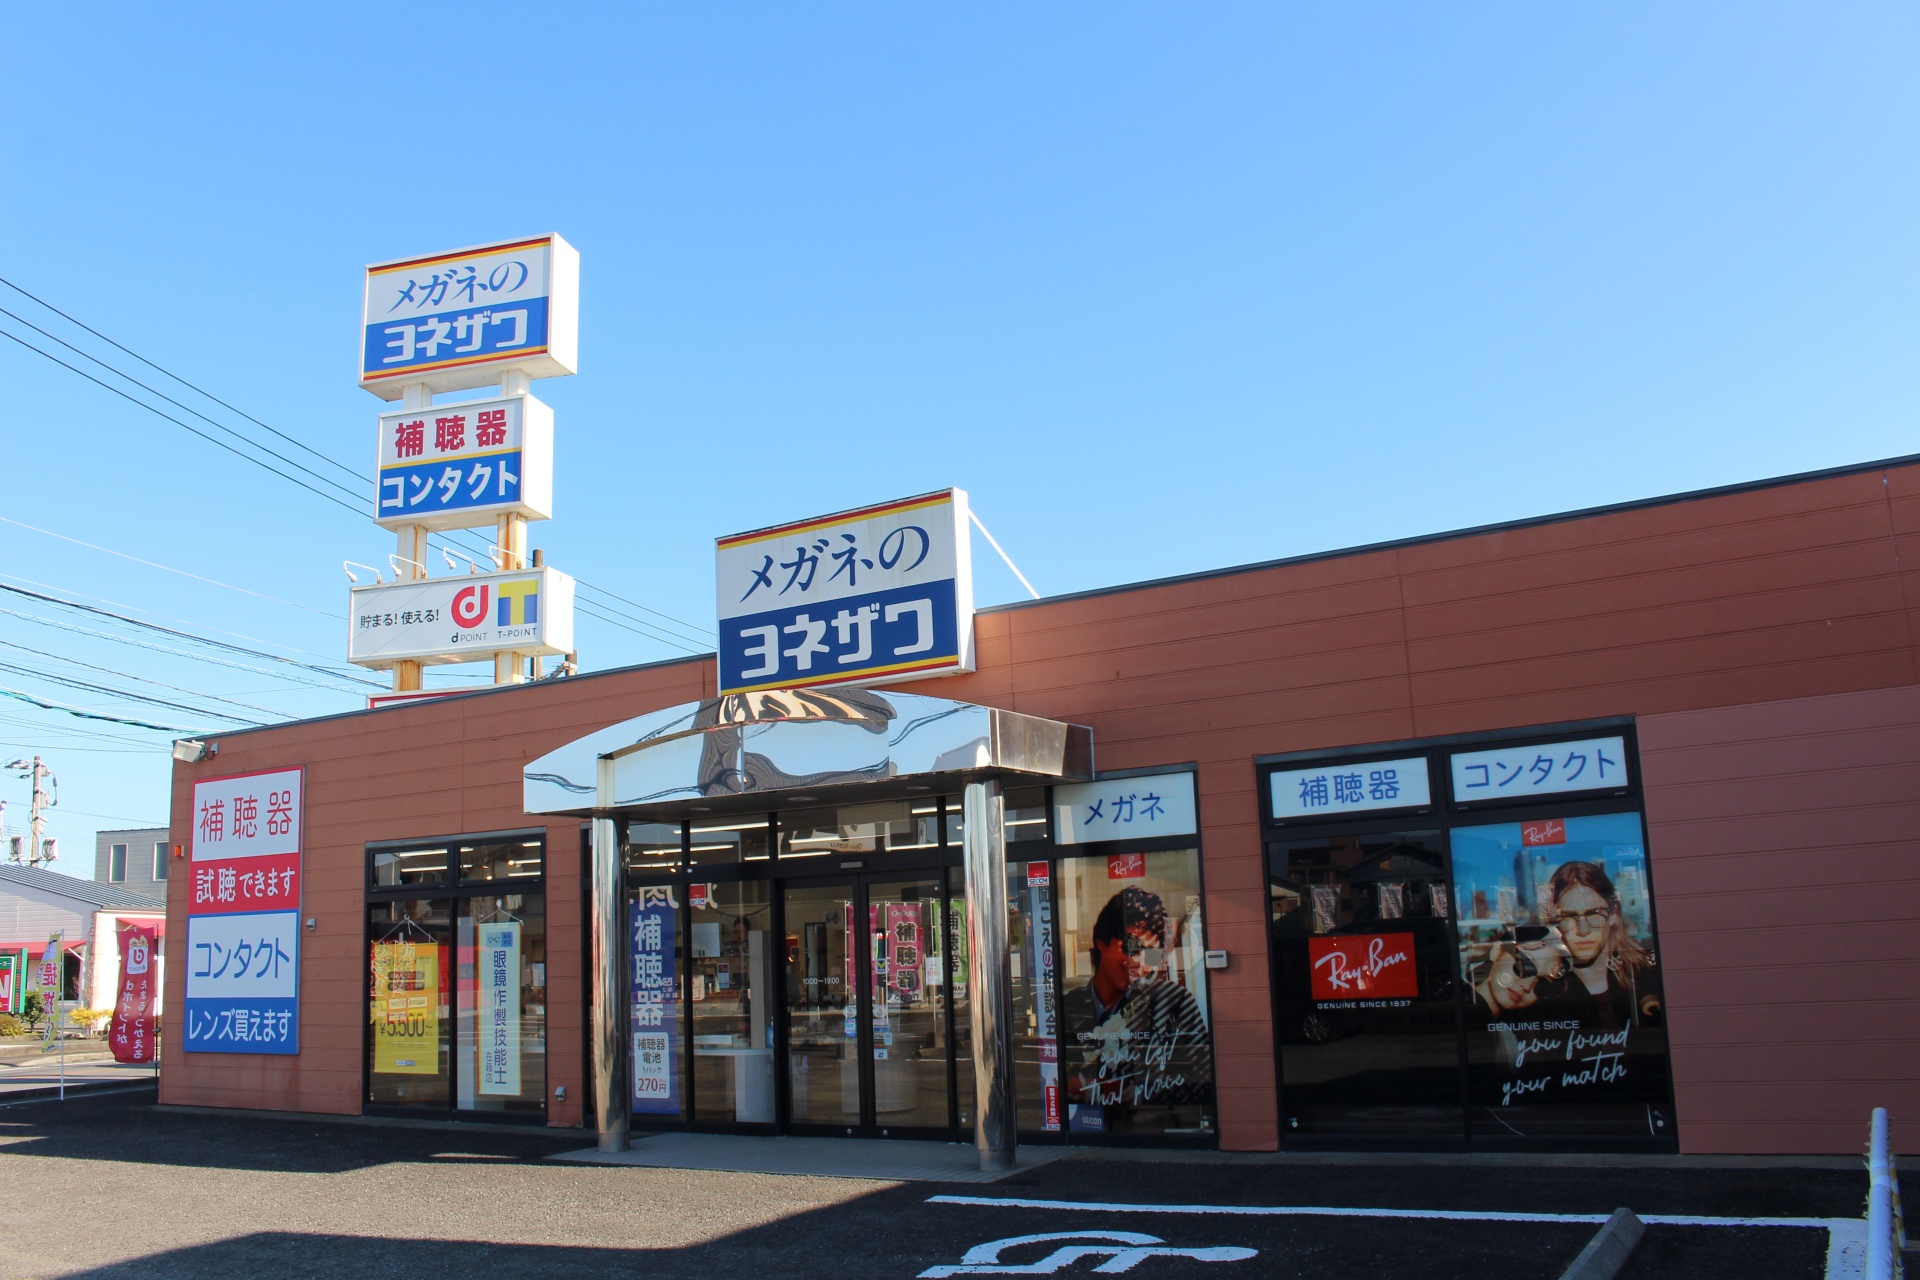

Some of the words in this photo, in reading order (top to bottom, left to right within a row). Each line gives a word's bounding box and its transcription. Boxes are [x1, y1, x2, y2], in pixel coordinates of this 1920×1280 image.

[387, 261, 529, 313] メガネの
[382, 308, 528, 363] ヨネザワ
[395, 409, 507, 458] 補聴器
[381, 460, 518, 508] コンタクト
[739, 525, 930, 603] メガネの
[460, 632, 488, 642] POINT
[498, 628, 538, 639] T-POINT
[740, 597, 934, 679] ヨネザワ
[1298, 769, 1401, 807] 補聴器
[1464, 748, 1616, 788] コンタクト
[200, 790, 293, 843] 補聴器
[1084, 792, 1165, 826] メガネ
[196, 866, 296, 904] 試聴できます
[195, 937, 290, 979] コンタクト
[634, 914, 665, 1027] 補聴器
[895, 922, 917, 989] 補聴器
[189, 1008, 292, 1043] レンズ買えます
[493, 950, 507, 1085] 眼鏡作製技能士
[1317, 1001, 1357, 1009] GENUINE
[1487, 1021, 1540, 1032] GENUINE
[1543, 1020, 1580, 1031] SINCE
[638, 1038, 666, 1051] 補聴器
[1077, 1031, 1119, 1041] GENUINE
[1121, 1030, 1151, 1040] SINCE
[1515, 1036, 1560, 1067] you
[1565, 1019, 1631, 1061] found
[642, 1052, 661, 1064] 電池
[1502, 1076, 1551, 1105] your
[1562, 1051, 1627, 1085] match
